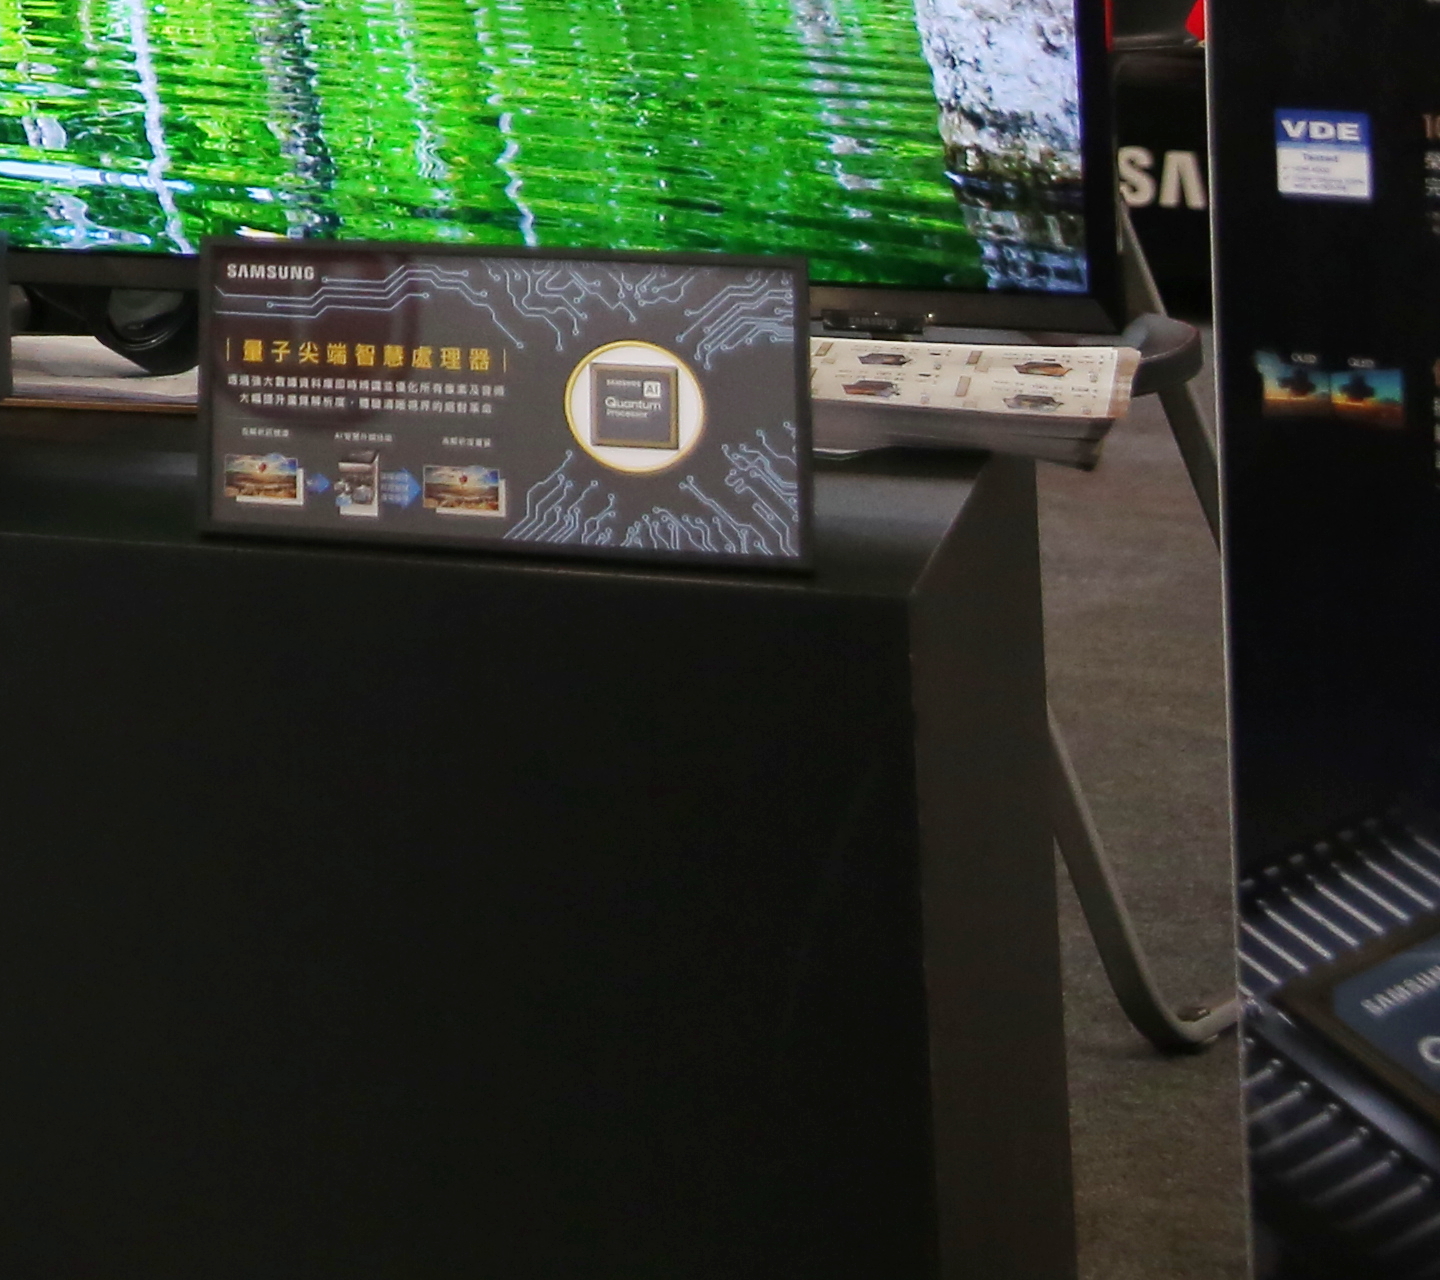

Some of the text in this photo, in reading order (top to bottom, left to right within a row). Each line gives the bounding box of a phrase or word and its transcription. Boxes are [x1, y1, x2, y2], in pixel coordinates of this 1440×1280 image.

[1281, 119, 1361, 142] VDE
[227, 264, 315, 282] SAMSUNG
[243, 339, 491, 372] 量子尖端智慧處理器
[605, 396, 662, 411] Quantum
